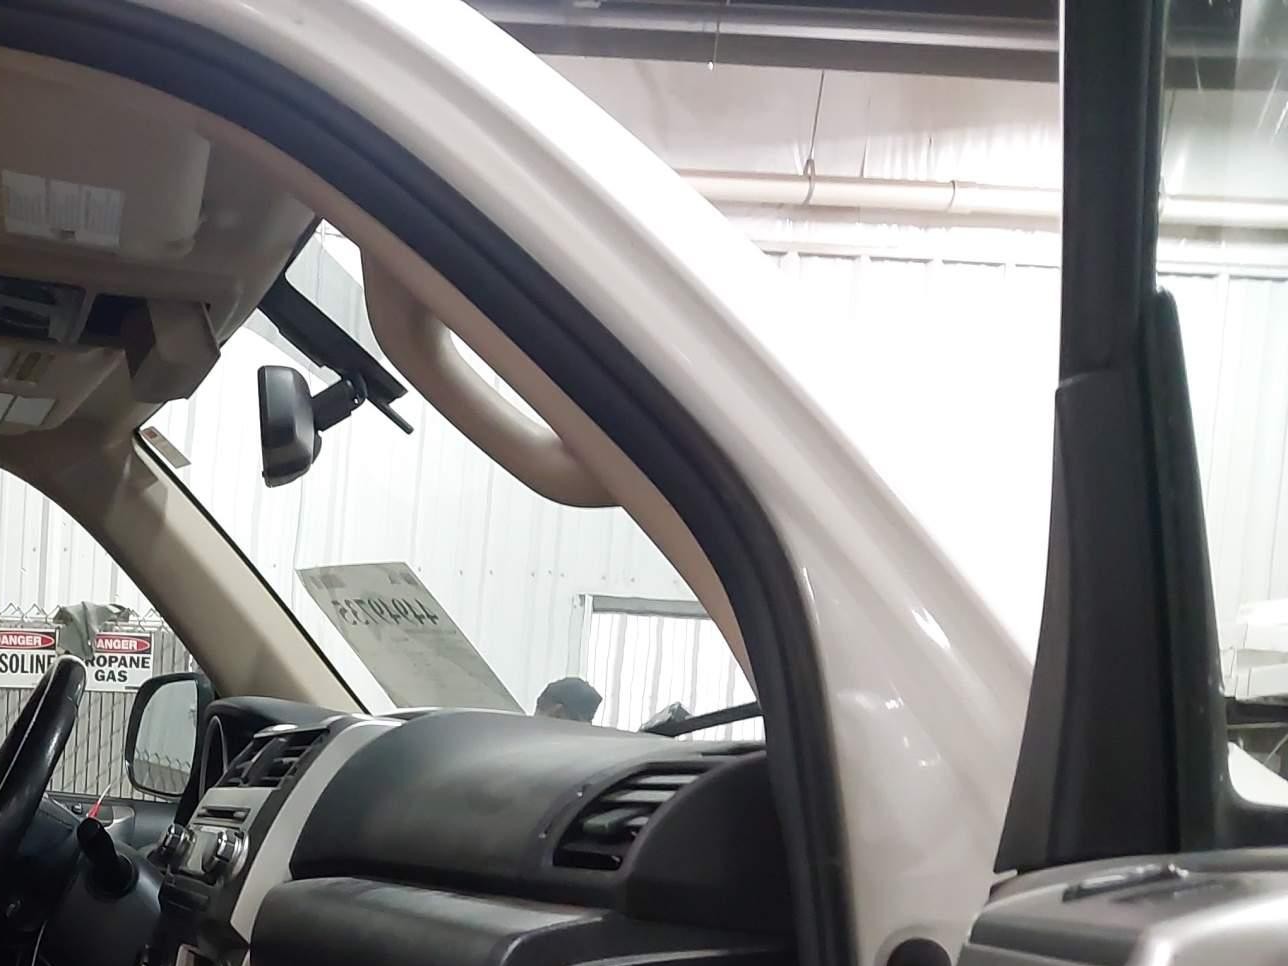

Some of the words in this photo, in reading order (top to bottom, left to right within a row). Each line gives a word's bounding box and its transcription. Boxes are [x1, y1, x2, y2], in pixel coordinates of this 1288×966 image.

[96, 639, 138, 651] ANGER
[85, 655, 151, 669] ROPANE
[94, 669, 128, 683] GAS
